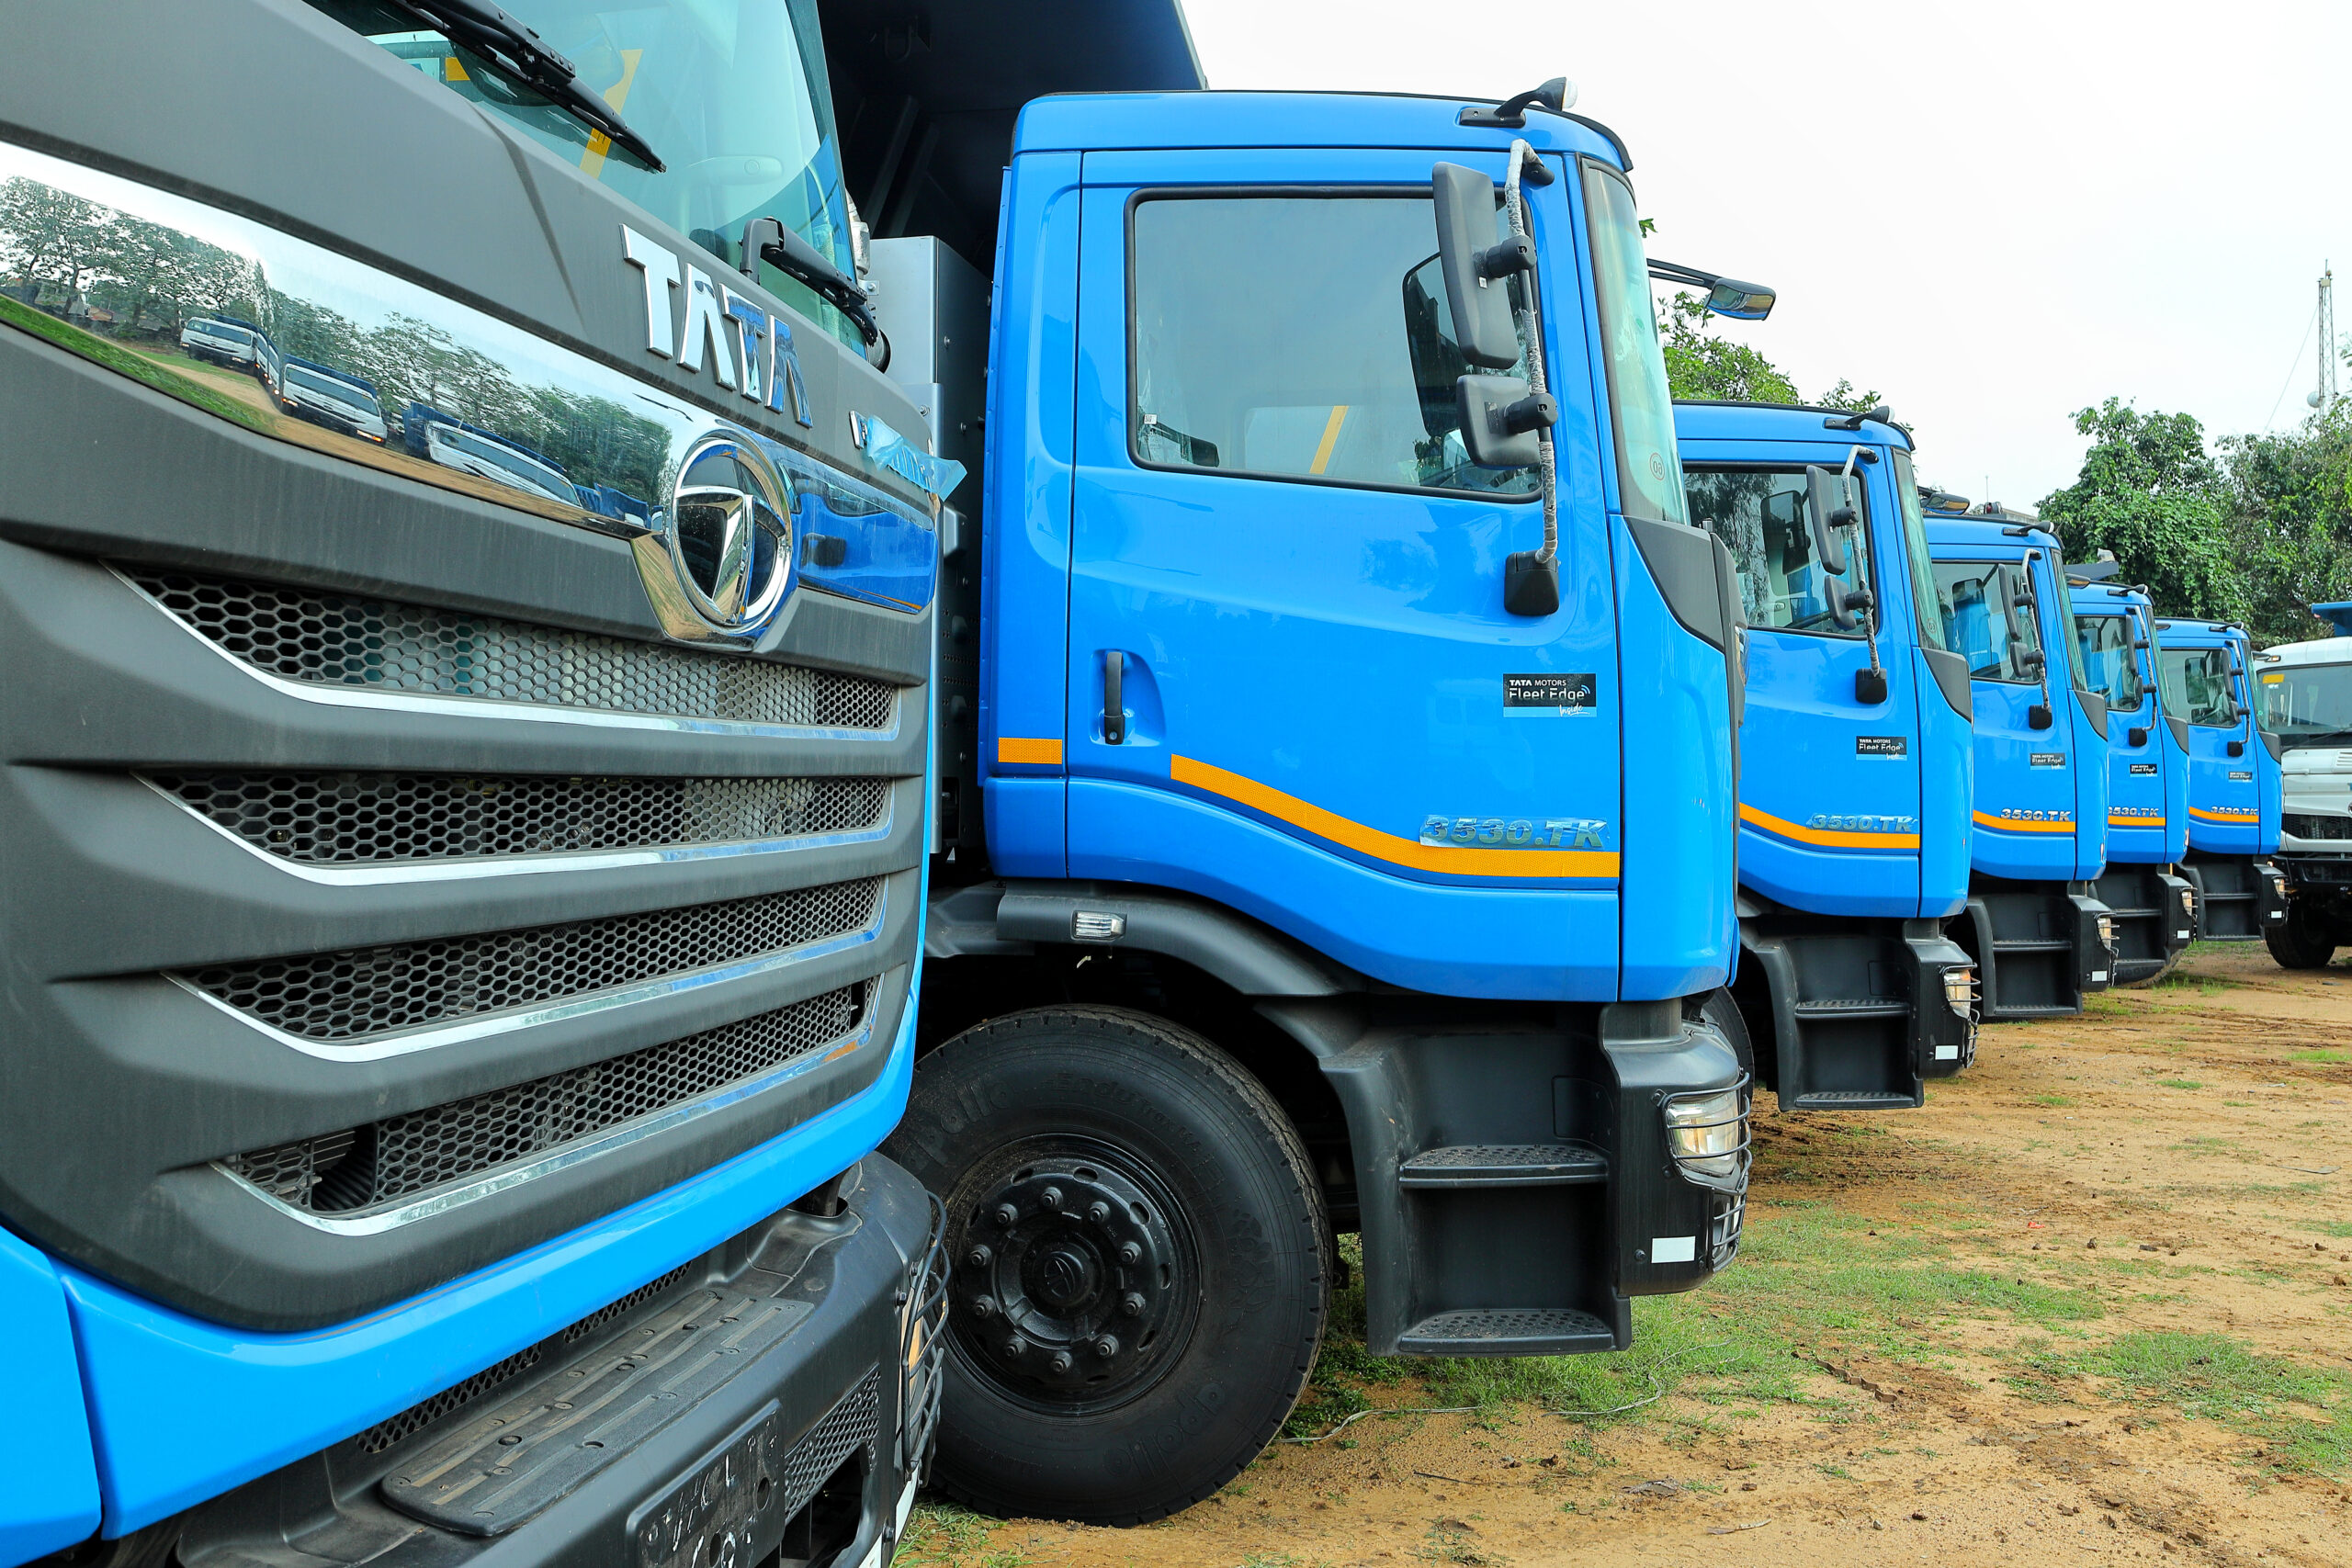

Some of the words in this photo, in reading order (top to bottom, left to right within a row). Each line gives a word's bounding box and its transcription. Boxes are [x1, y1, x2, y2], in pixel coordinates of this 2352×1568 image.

[619, 223, 813, 428] TATA
[1534, 679, 1566, 687] MOTORS
[1509, 687, 1545, 700] Fleet
[1549, 687, 1585, 702] Edge
[1881, 743, 1901, 751] Edge
[2000, 807, 2071, 822] 3530.TK
[1812, 814, 1914, 832] 3530.TK
[1422, 816, 1607, 848] 3530.TK
